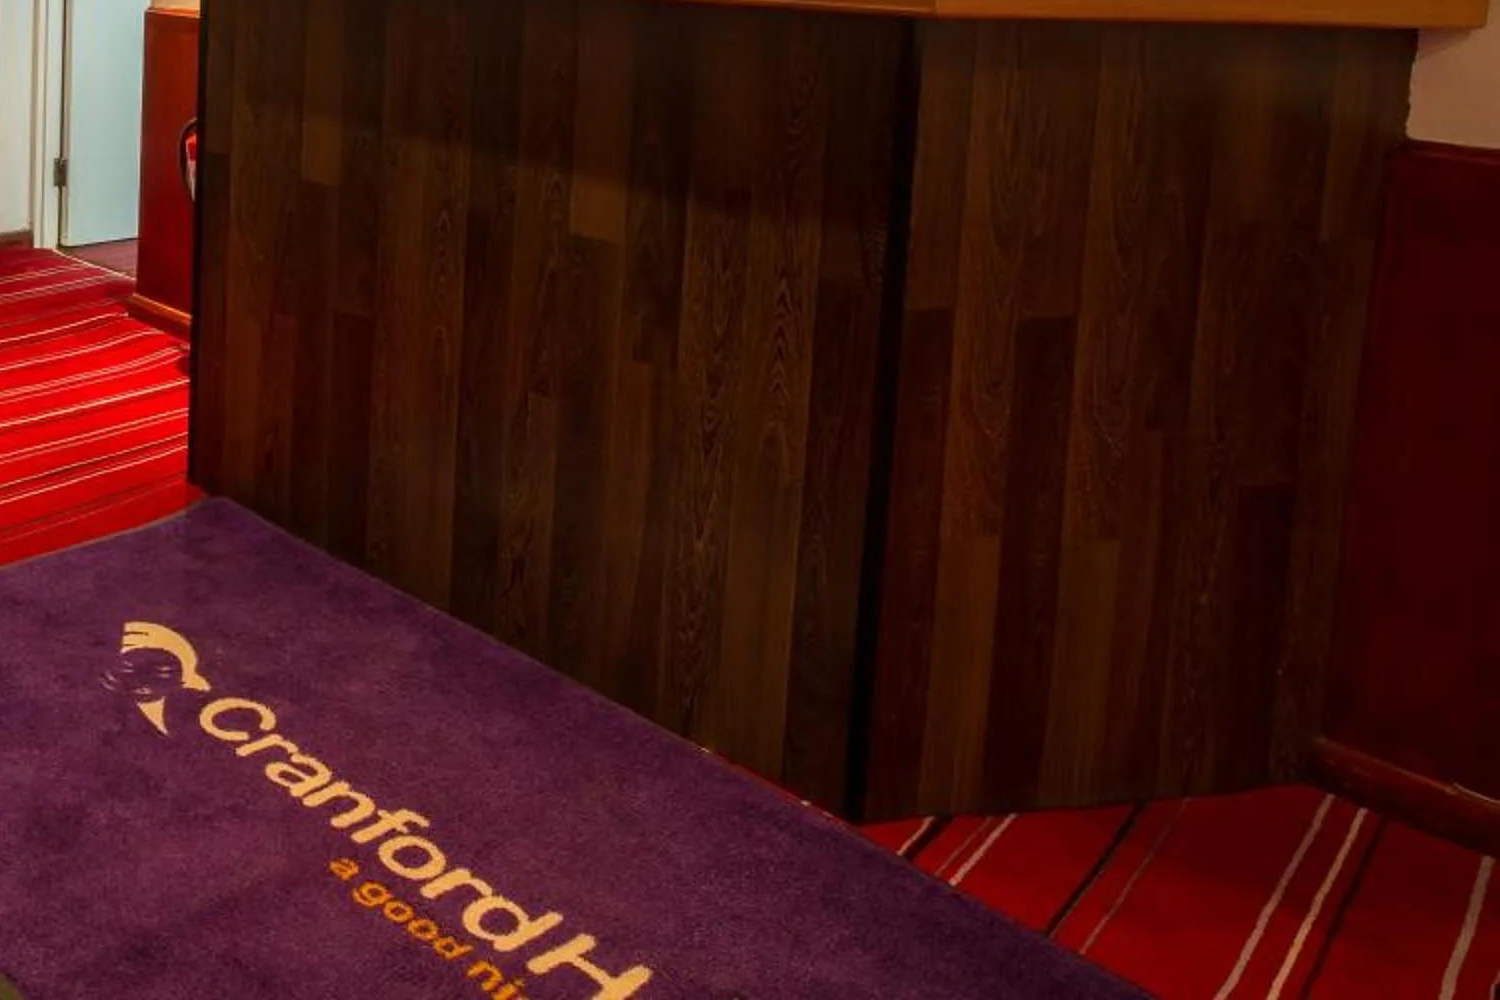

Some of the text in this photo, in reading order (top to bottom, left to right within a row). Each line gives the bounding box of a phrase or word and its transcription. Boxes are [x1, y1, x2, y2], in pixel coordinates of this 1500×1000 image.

[199, 696, 564, 952] Cranford
[329, 856, 360, 882] a
[351, 880, 472, 962] good
